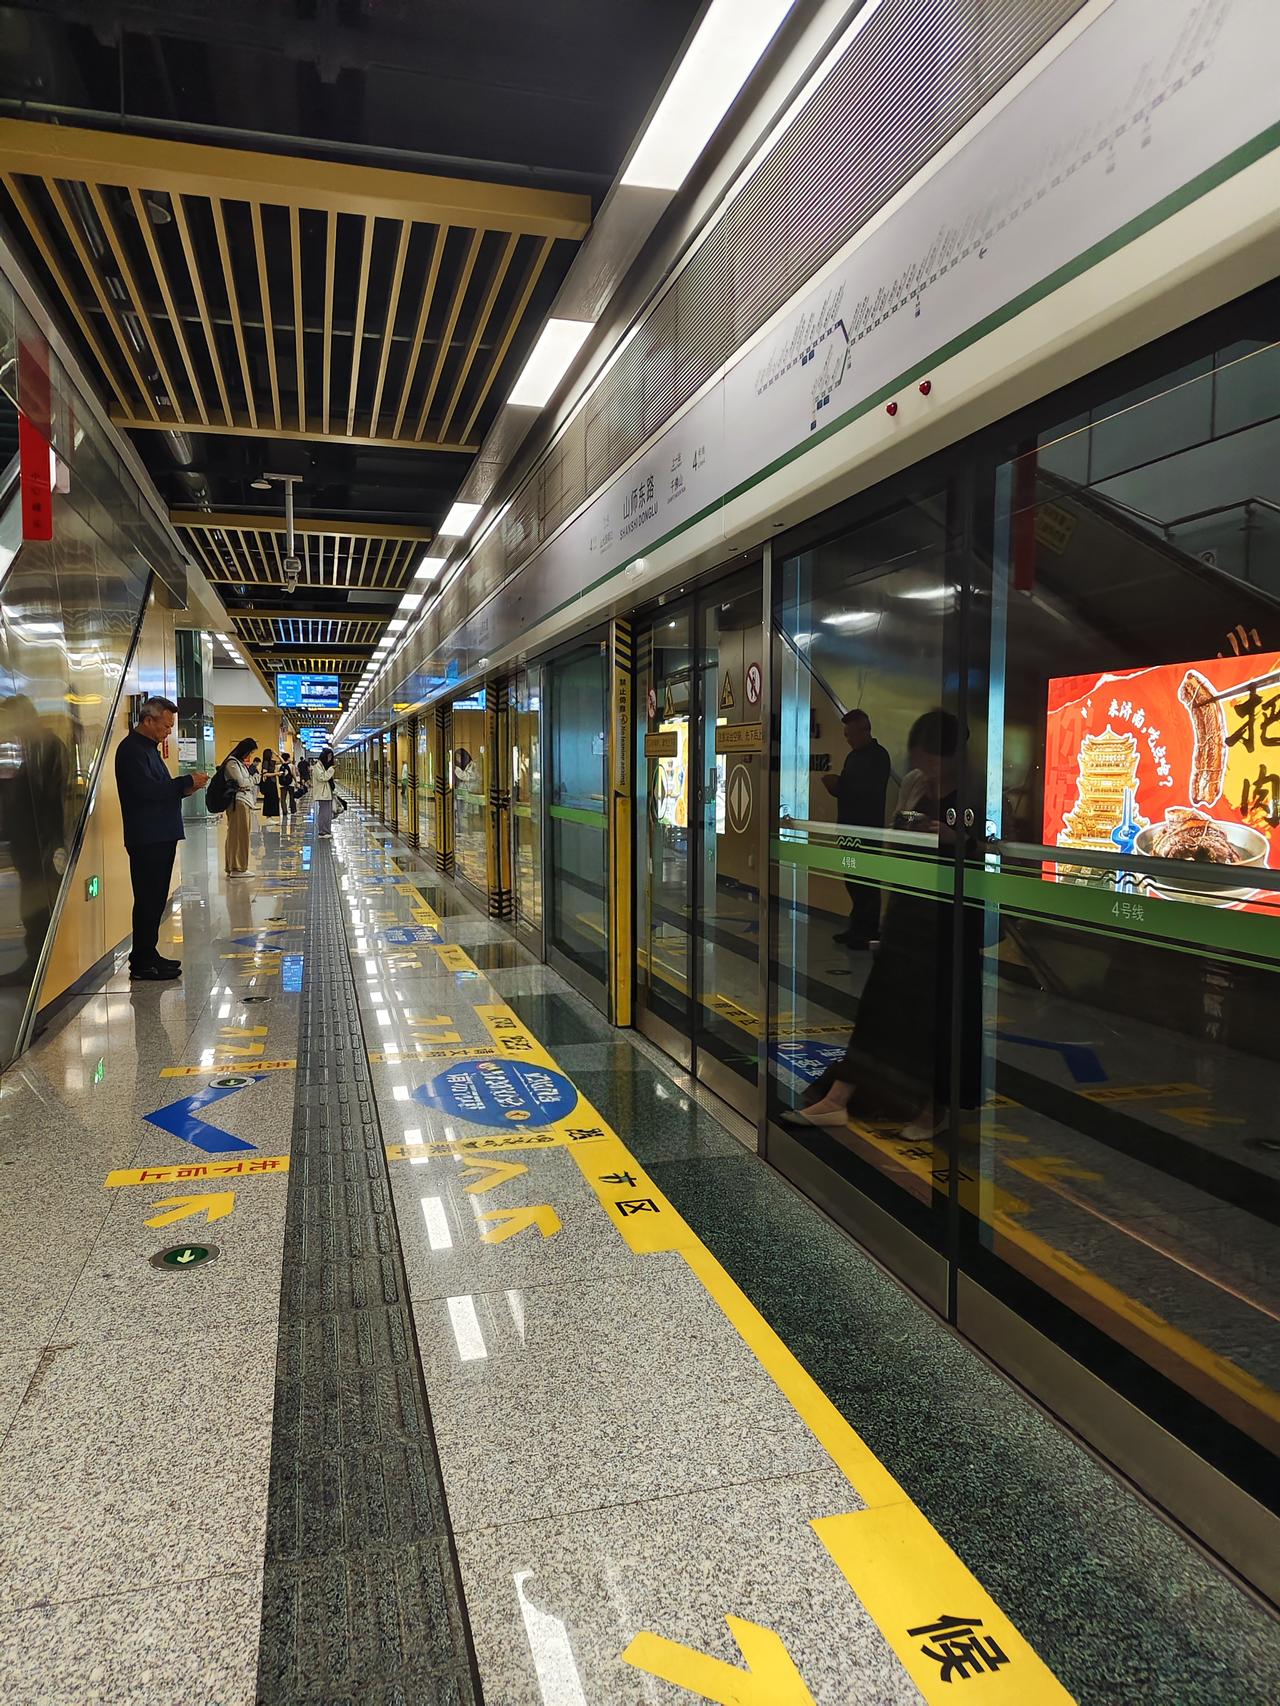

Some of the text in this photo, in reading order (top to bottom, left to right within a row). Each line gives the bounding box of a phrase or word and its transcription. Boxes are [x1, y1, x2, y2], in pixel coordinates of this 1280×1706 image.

[623, 475, 655, 519] 山师东路
[841, 856, 857, 869] 4号线
[1111, 901, 1145, 921] 4号线
[139, 1160, 281, 1182] 先下后上
[906, 1614, 1011, 1683] 候
